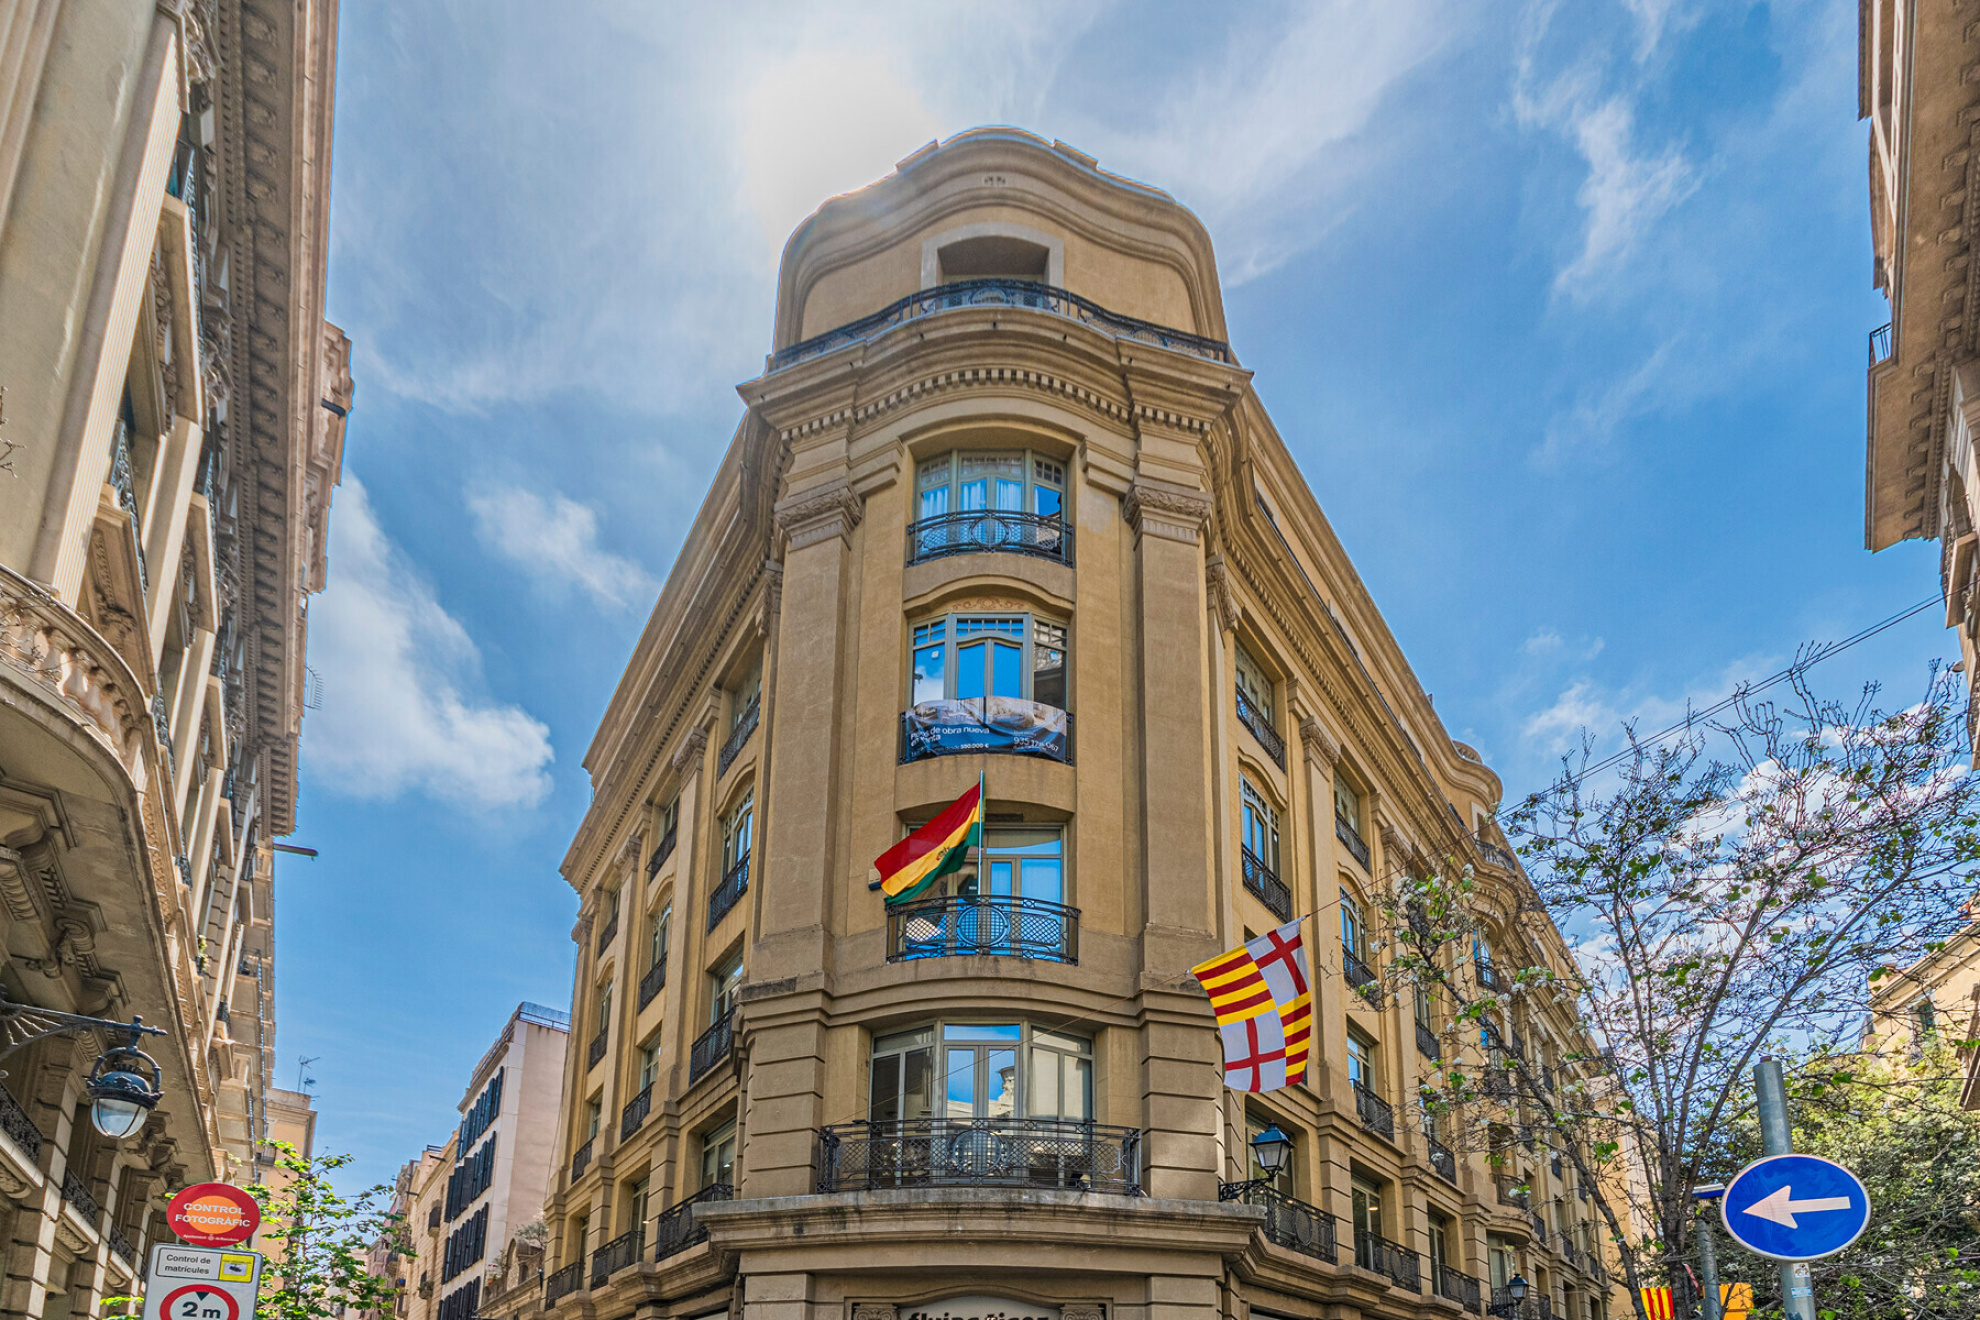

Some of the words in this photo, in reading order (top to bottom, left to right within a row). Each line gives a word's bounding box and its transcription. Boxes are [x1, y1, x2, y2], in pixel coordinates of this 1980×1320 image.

[930, 726, 941, 735] de
[942, 726, 962, 735] obra
[963, 726, 990, 735] nueva
[1013, 736, 1030, 746] 935
[183, 1203, 246, 1215] CONTROL
[175, 1213, 251, 1227] FOTOGRÀFIC
[166, 1254, 199, 1263] Control
[164, 1265, 210, 1274] matrícules
[182, 1301, 199, 1317] 2
[202, 1308, 221, 1319] m
